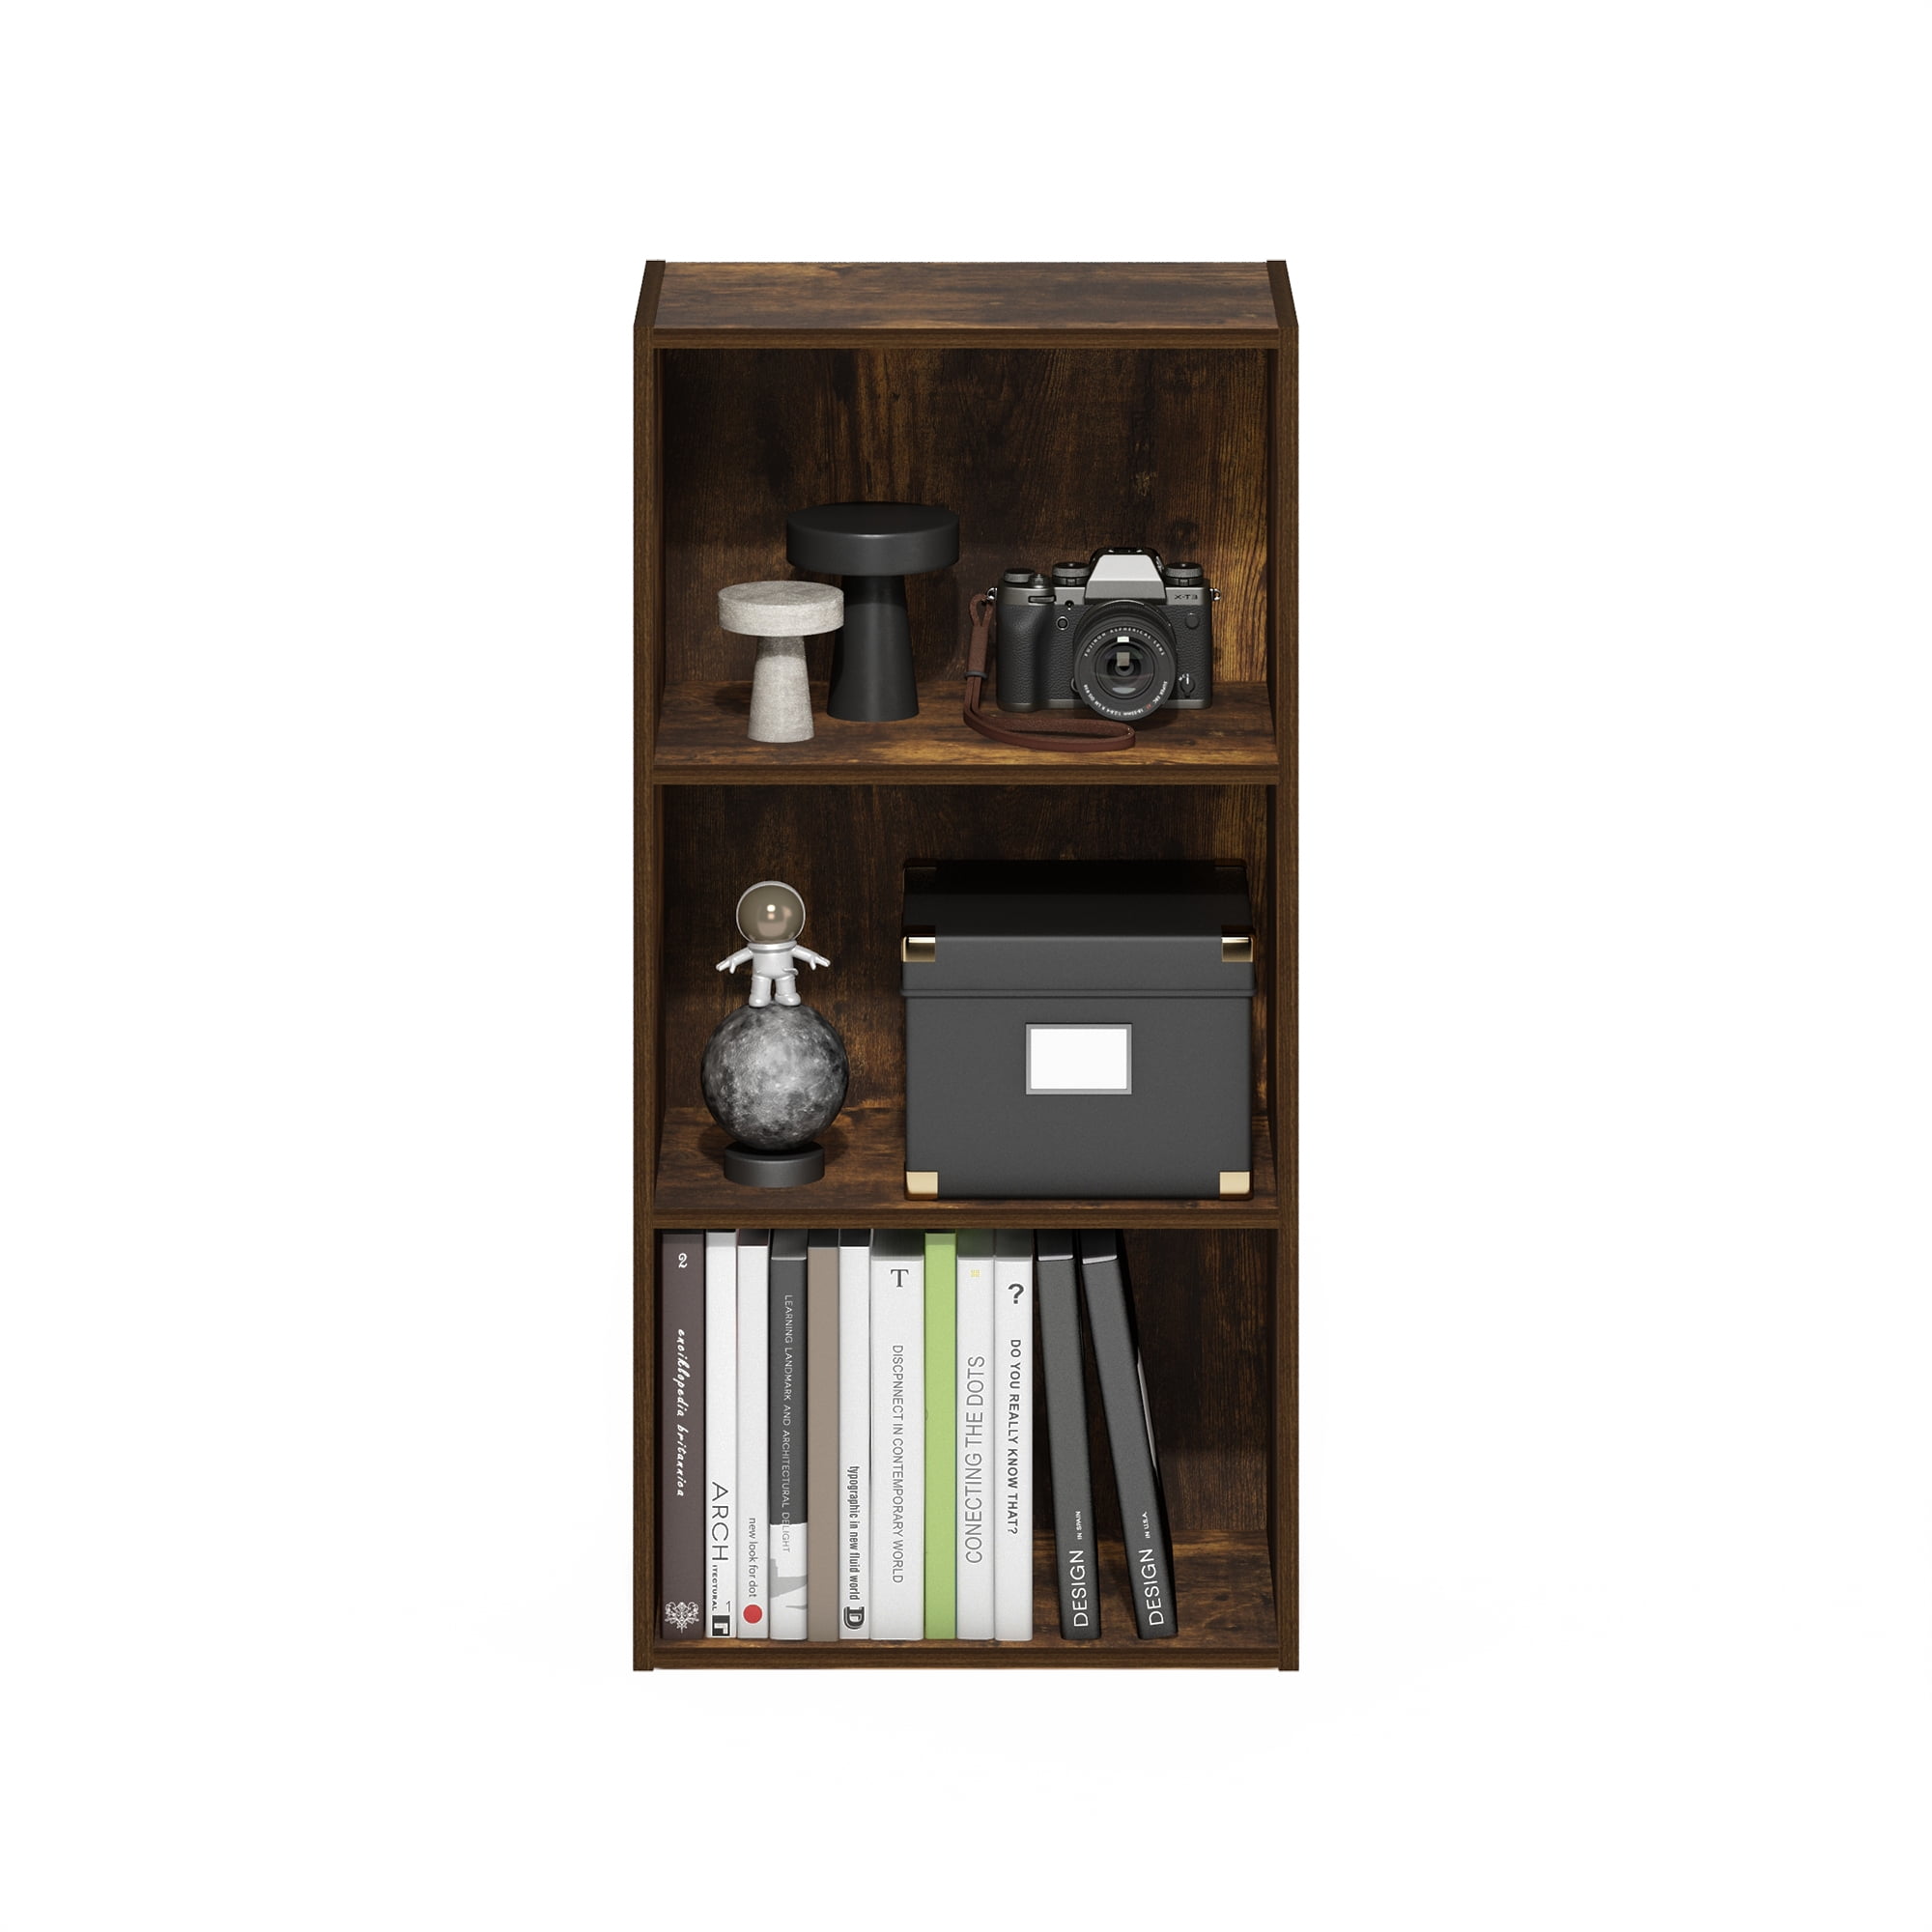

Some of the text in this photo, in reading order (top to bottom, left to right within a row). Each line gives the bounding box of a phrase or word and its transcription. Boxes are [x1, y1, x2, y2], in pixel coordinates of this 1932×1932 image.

[890, 1268, 909, 1288] T
[1008, 1283, 1025, 1305] ?
[781, 1294, 793, 1553] LEARNING LANDMARK AND ARCHITECTURAL DELIGHT
[964, 1355, 985, 1564] CONECTING THE DOTS
[1007, 1339, 1022, 1535] DO YOU REALLY KNOW THAT?
[892, 1345, 904, 1583] DISCPNNECT IN CONTEMPORARY WORLD
[748, 1518, 760, 1598] new look for dot
[846, 1465, 861, 1601] typographic in new fluid world
[1076, 1532, 1082, 1541] IN
[1144, 1530, 1151, 1539] IN
[1068, 1549, 1089, 1627] DESIGN
[1138, 1548, 1165, 1626] DESIGN
